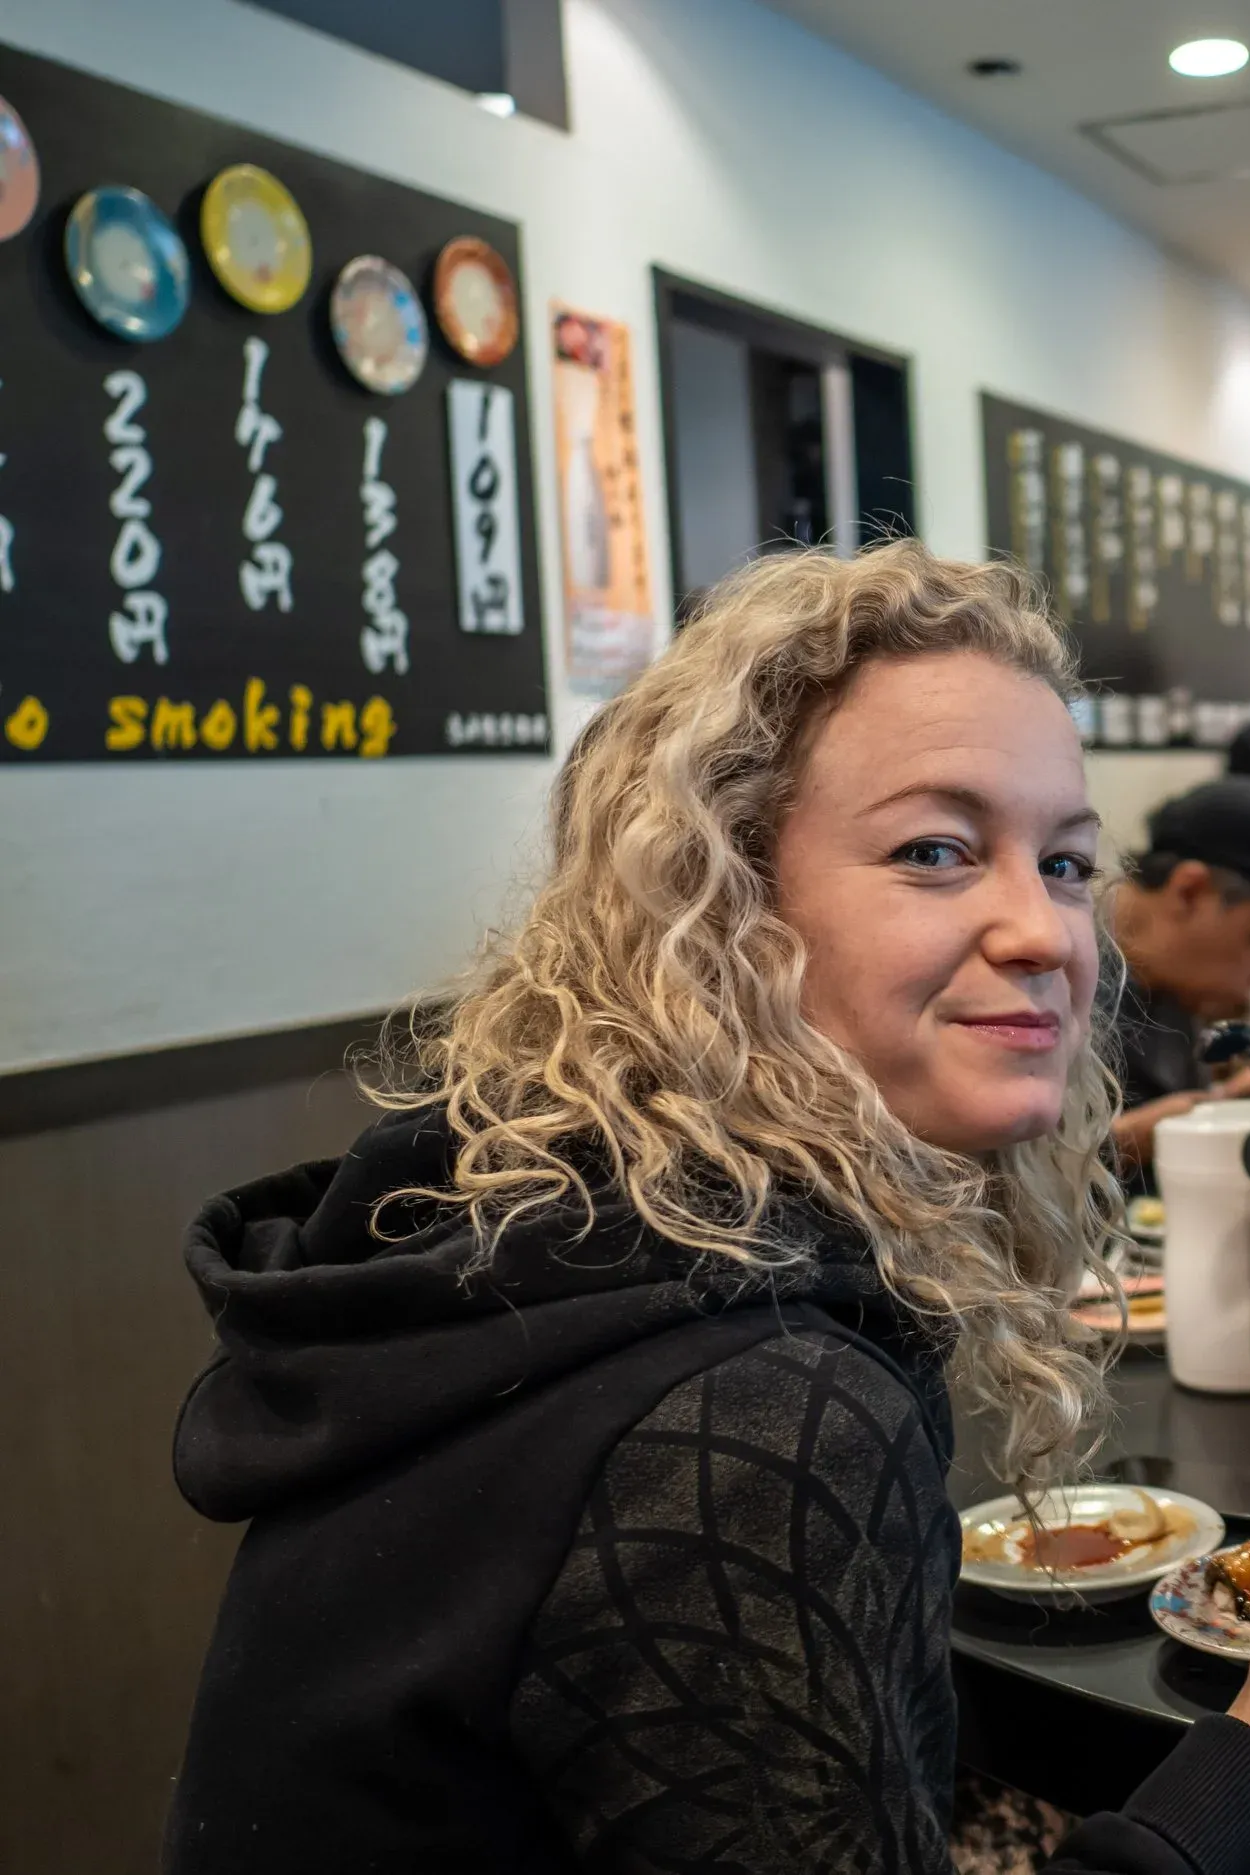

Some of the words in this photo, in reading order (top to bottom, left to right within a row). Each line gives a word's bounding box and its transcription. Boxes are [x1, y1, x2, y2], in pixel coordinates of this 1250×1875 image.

[103, 369, 168, 665] 220円
[359, 416, 410, 675] 138円
[105, 677, 396, 756] smoking
